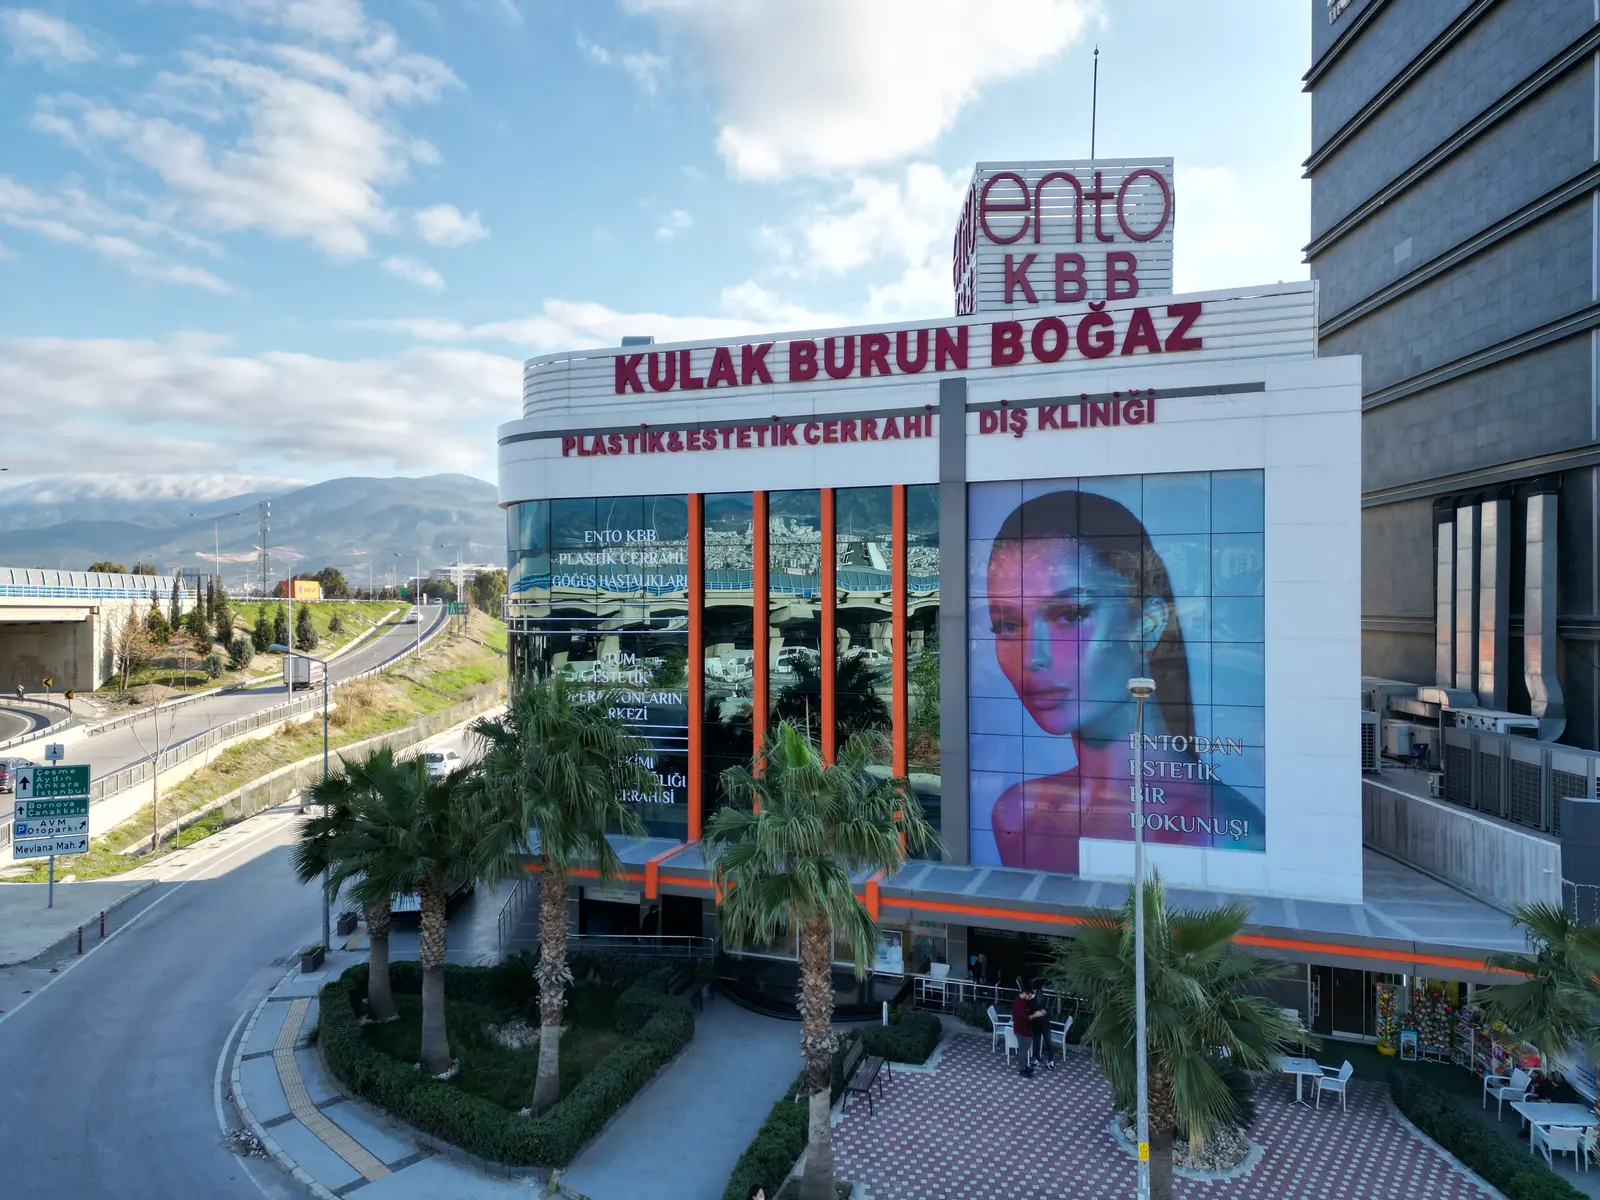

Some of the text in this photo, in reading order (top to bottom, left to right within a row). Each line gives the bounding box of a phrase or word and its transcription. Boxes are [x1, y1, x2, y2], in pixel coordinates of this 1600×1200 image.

[979, 168, 1171, 245] ento
[1004, 251, 1139, 304] KBB
[615, 300, 1203, 394] KULAK BURUN BOĞAZ
[979, 388, 1156, 438] DİŞ KLİNİĞİ
[803, 404, 933, 445] CERRAHİ
[584, 529, 656, 543] ENTO KBB
[559, 552, 617, 566] PLASTİK
[552, 572, 688, 588] GÖĞÜS HASTALIKLARI
[607, 650, 636, 665] TÜM
[28, 808, 86, 816] Çanakkale
[28, 826, 77, 835] Otoparkı
[40, 819, 65, 827] AVM
[15, 842, 76, 854] Mevlana Mah.
